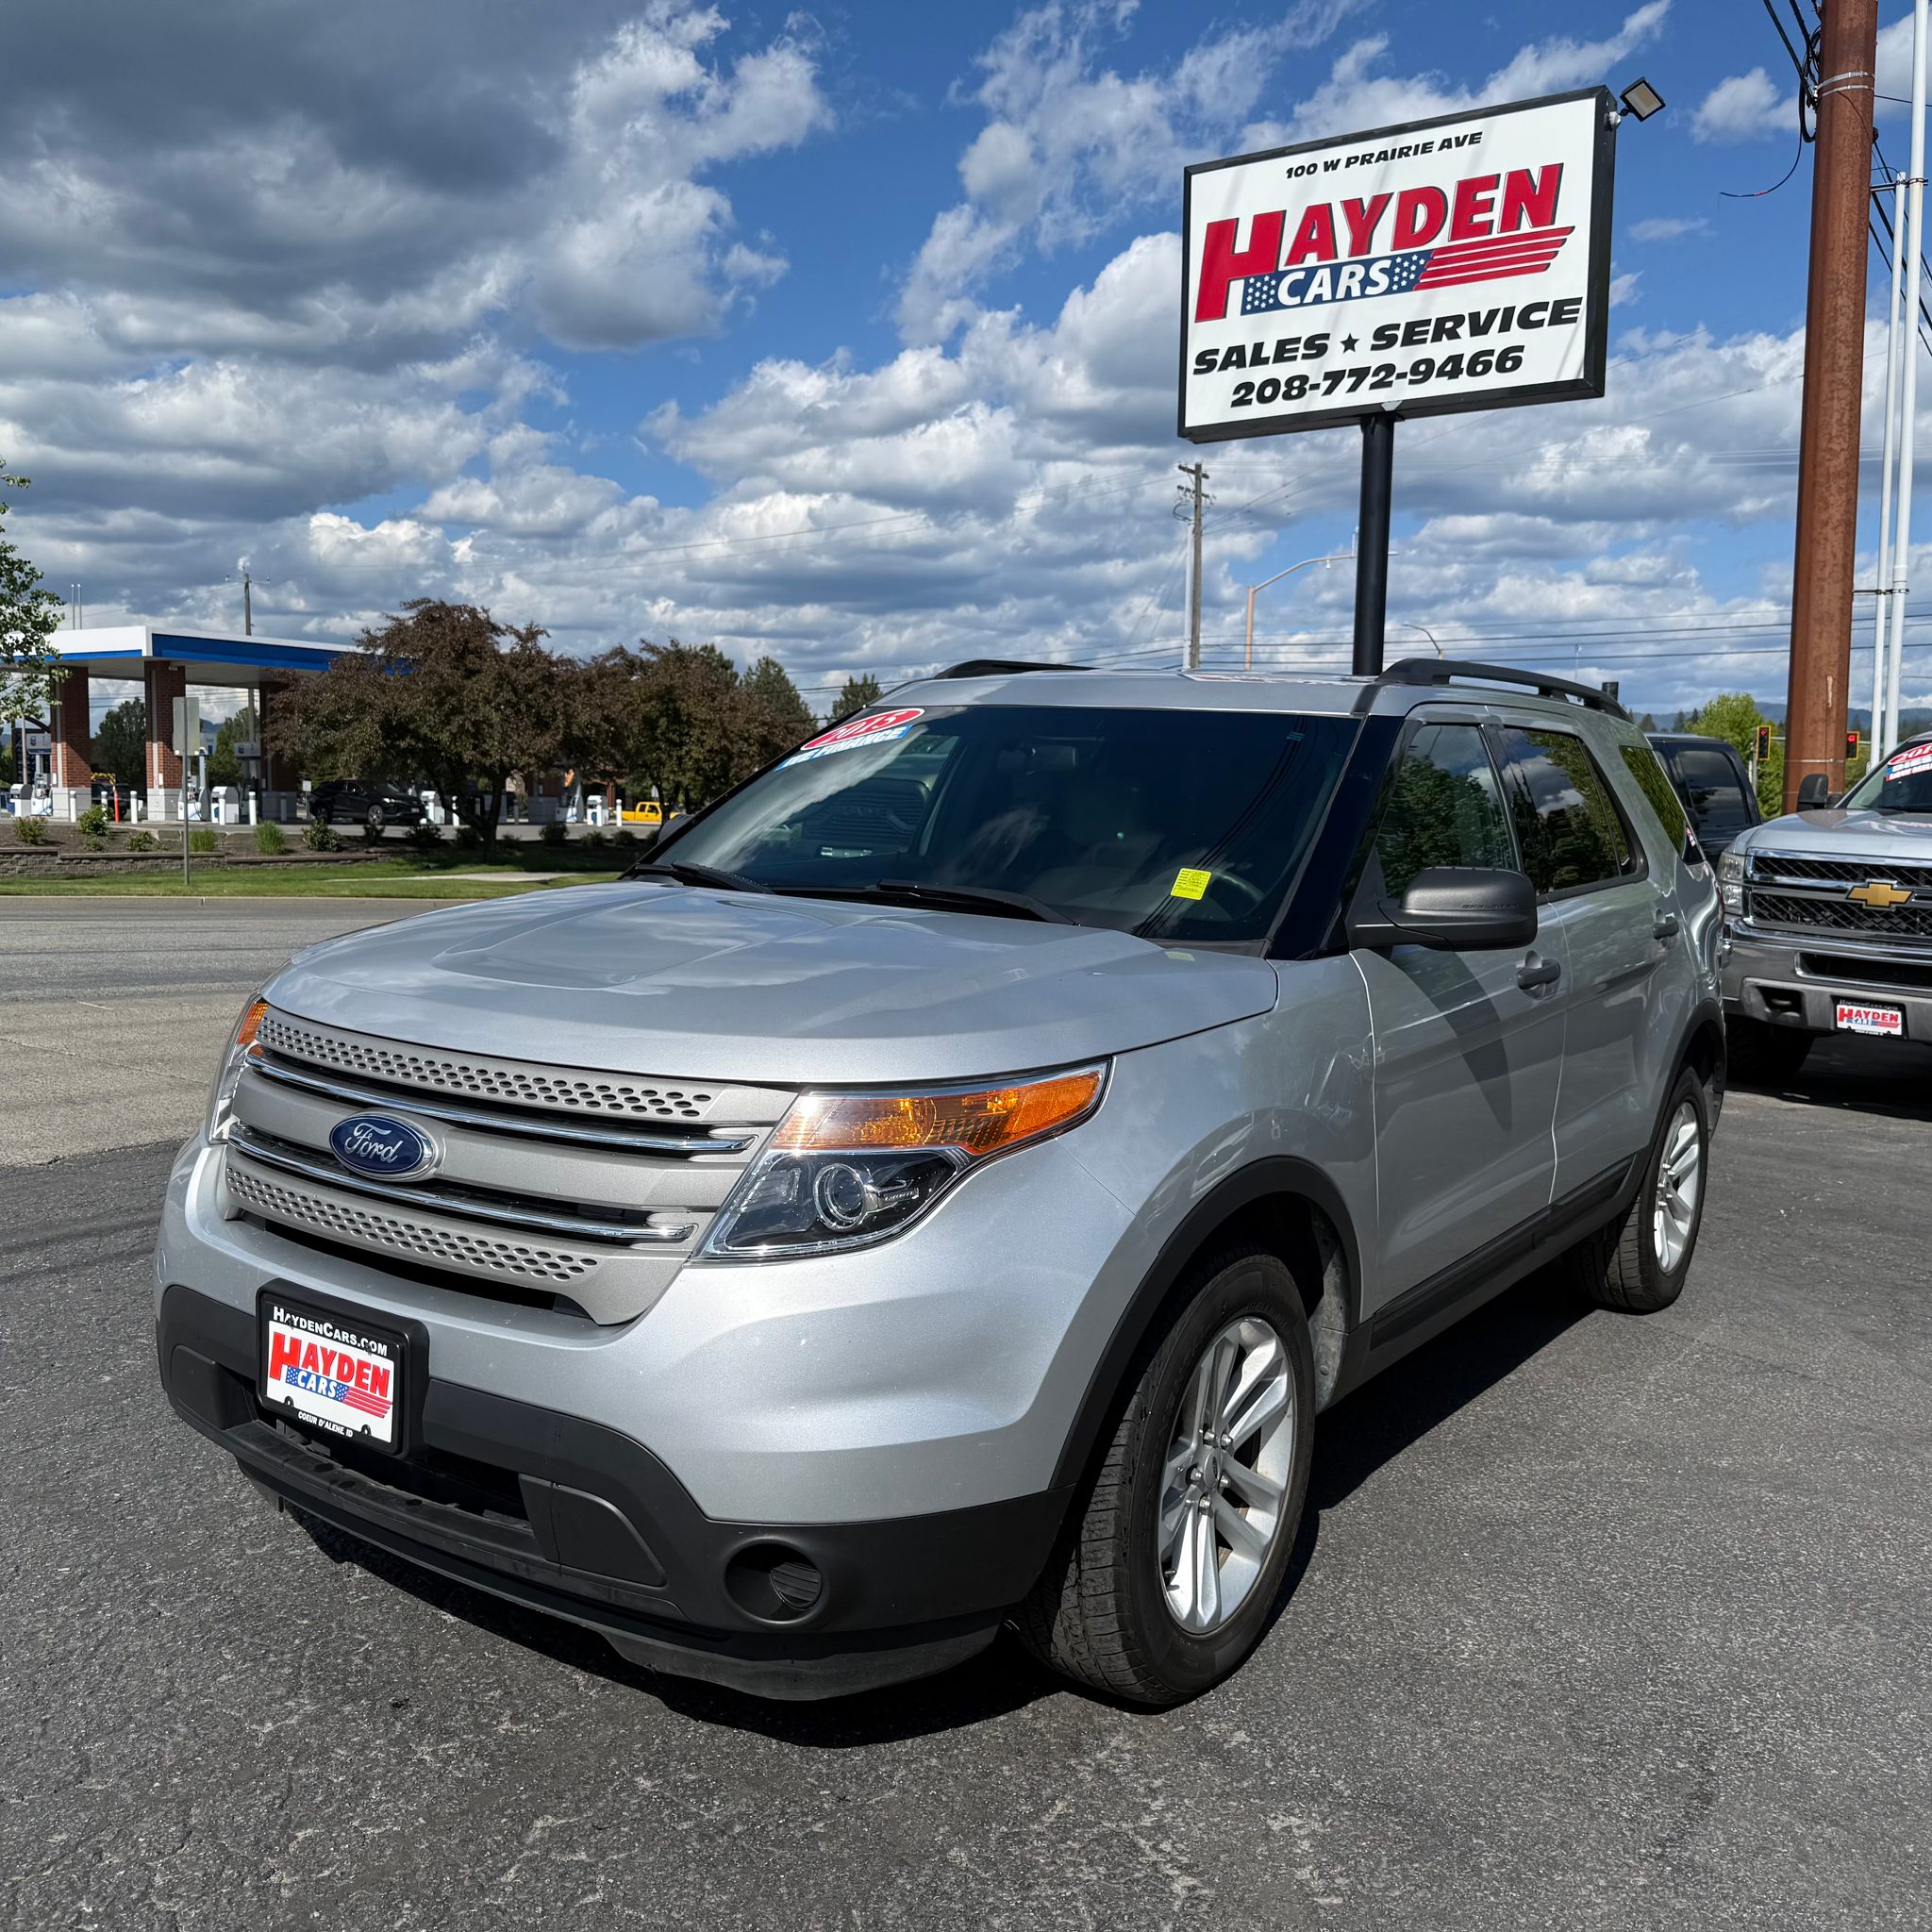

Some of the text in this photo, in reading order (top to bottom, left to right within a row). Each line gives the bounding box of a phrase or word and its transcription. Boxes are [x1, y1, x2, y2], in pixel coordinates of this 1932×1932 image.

[1286, 131, 1483, 179] 100 W PRAIRIE AVE
[1194, 162, 1564, 323] HAYDEN
[1276, 258, 1392, 307] CARS
[1192, 296, 1584, 375] SALES SERVICE
[1230, 345, 1525, 408] 208-772-9466
[812, 726, 908, 758] FINANCE
[1838, 1008, 1898, 1023] HAYDEN
[344, 1123, 404, 1164] Ford
[269, 1331, 391, 1398] HAYDEN
[297, 1371, 337, 1399] CARS
[297, 1411, 318, 1425] COEUR
[345, 1428, 354, 1438] ID
